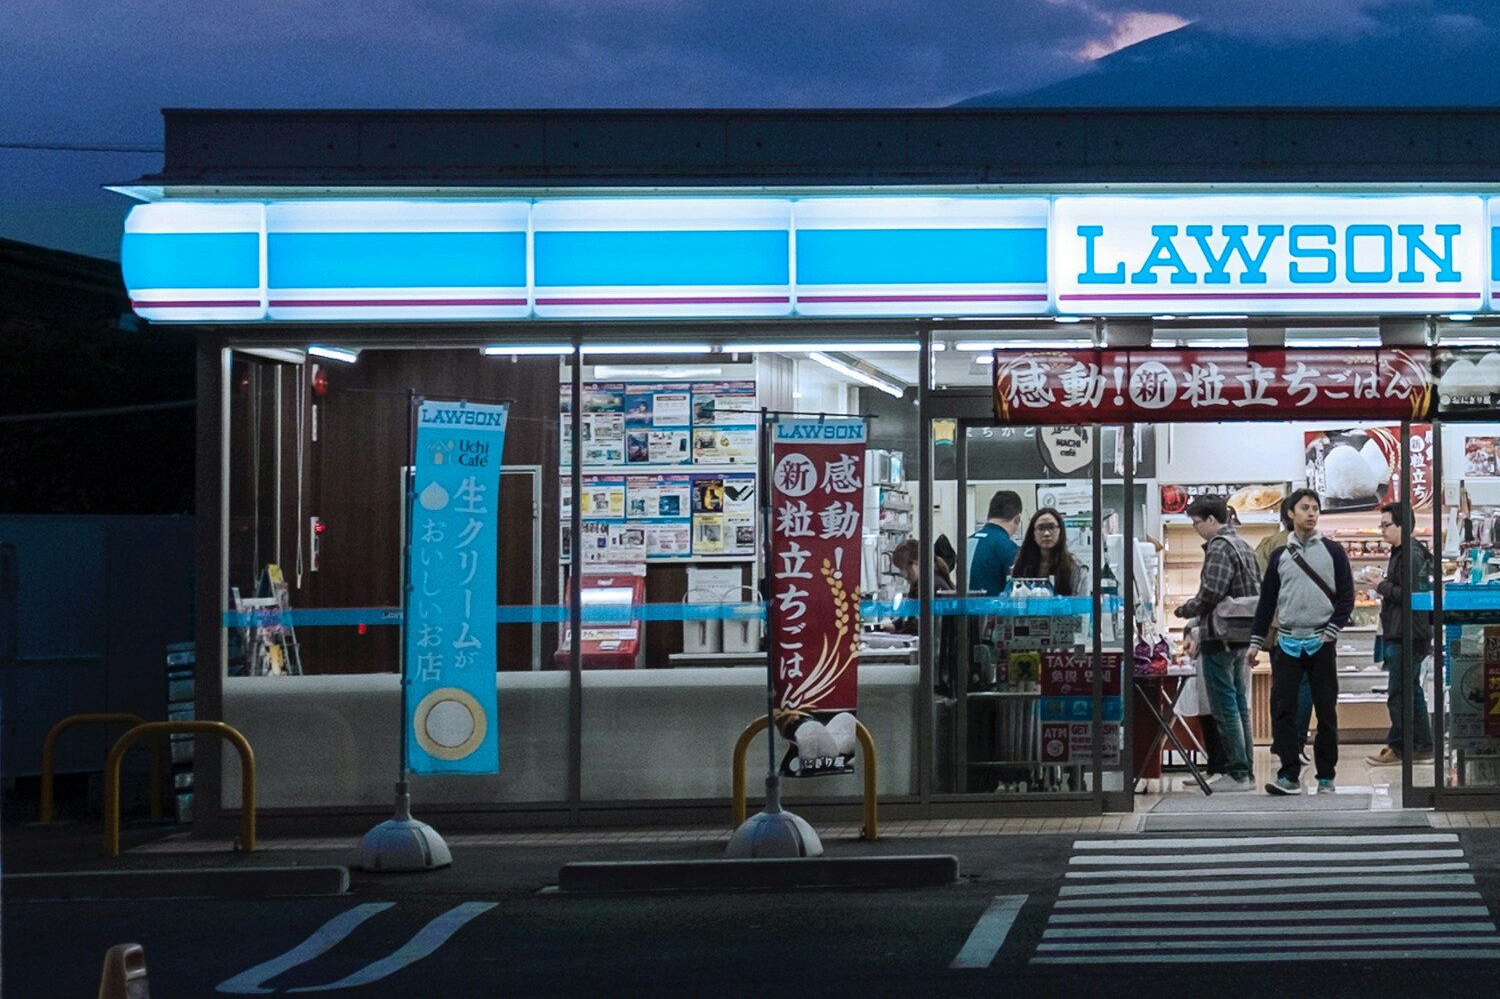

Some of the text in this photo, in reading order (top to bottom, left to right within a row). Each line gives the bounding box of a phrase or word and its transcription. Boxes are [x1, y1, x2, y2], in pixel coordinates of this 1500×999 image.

[1077, 224, 1462, 284] LAWSON
[421, 409, 503, 427] LAWSON
[777, 424, 864, 439] LAWSON
[459, 439, 489, 454] Uchi
[1056, 438, 1081, 448] MACHI
[458, 453, 489, 467] Café
[453, 475, 488, 668] 生クリームが
[416, 518, 447, 682] おいしいお店
[1044, 728, 1067, 738] ATM
